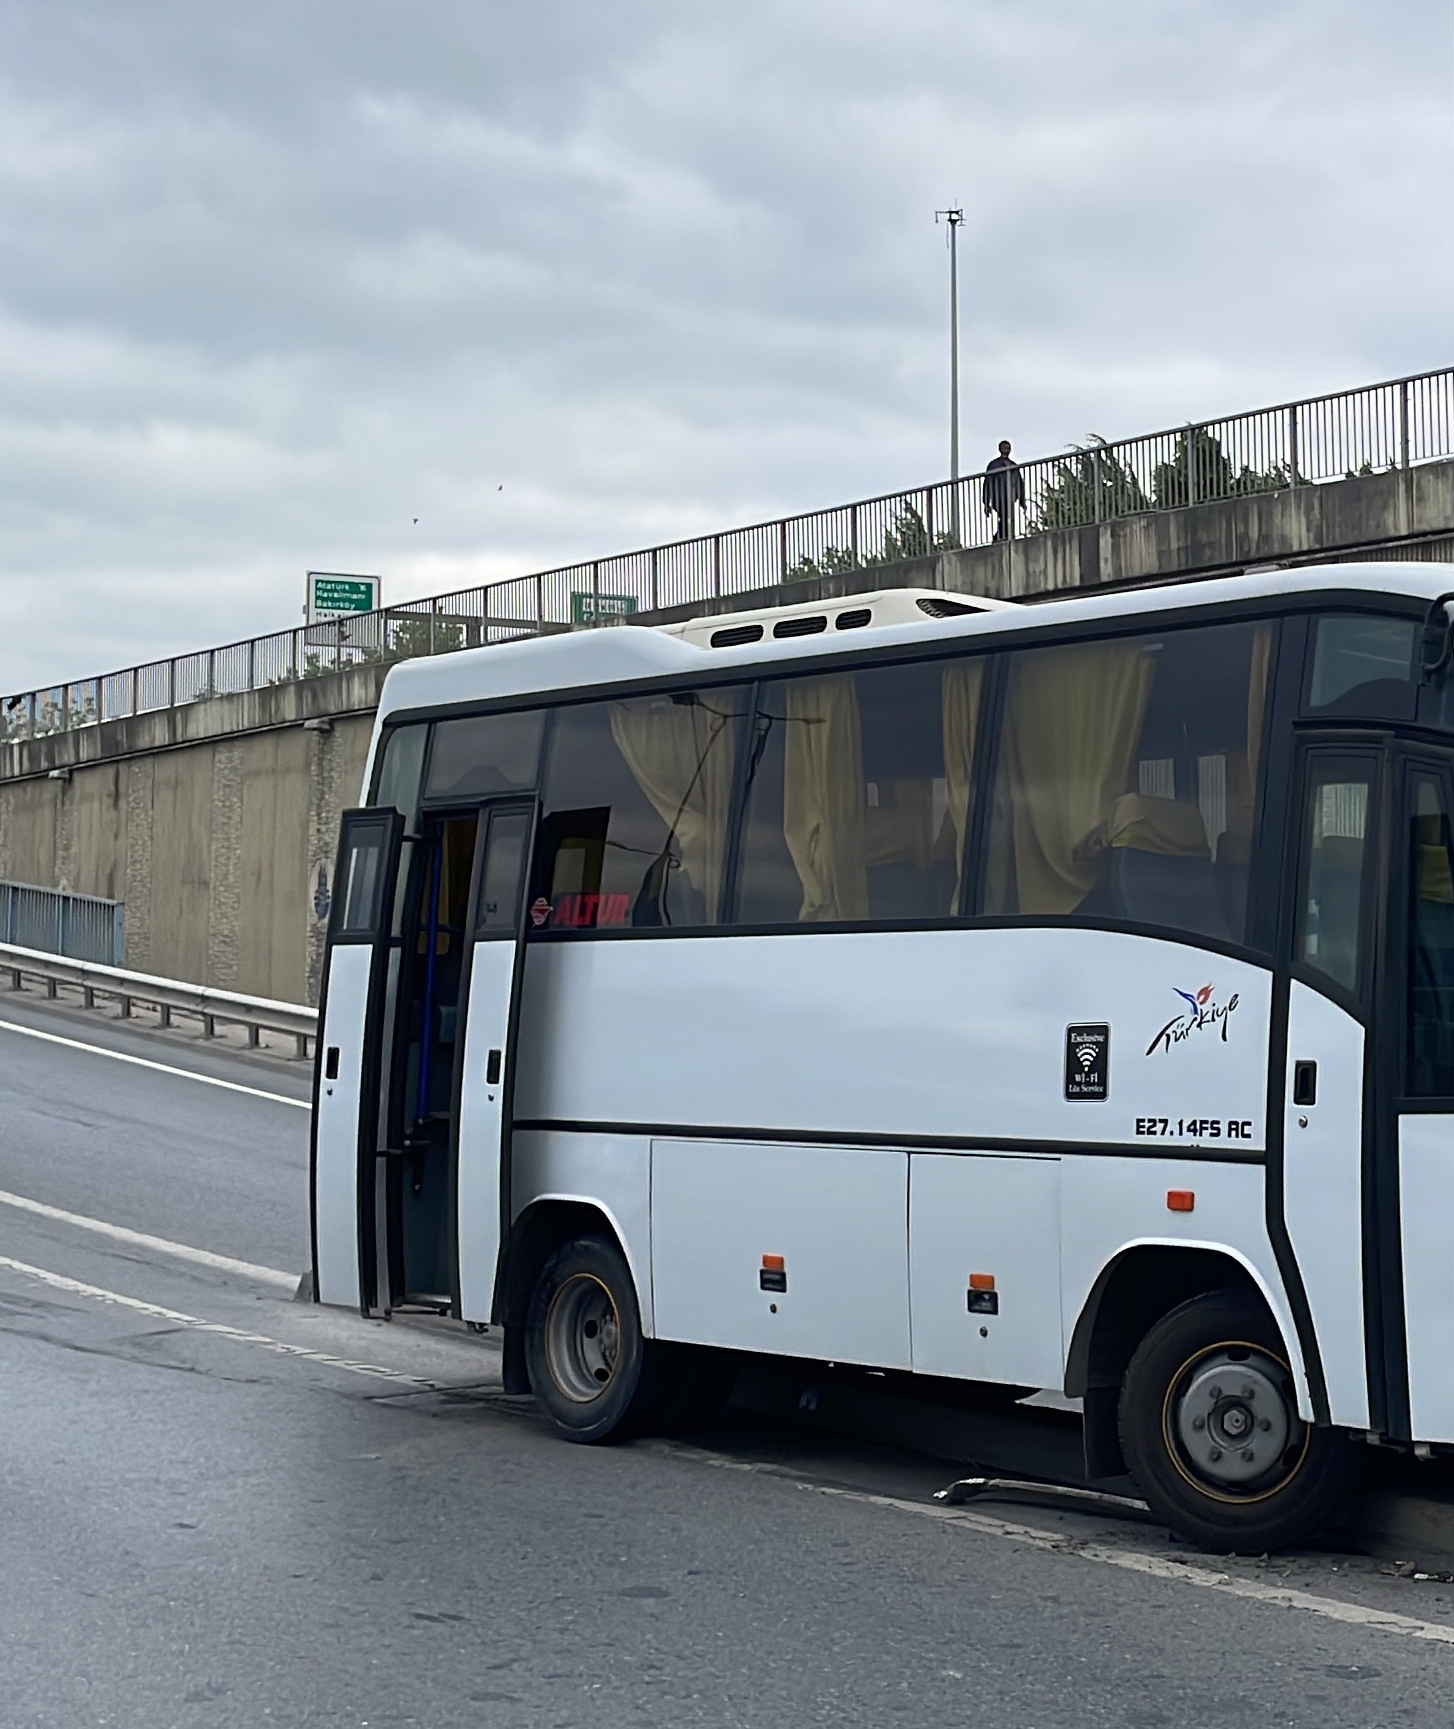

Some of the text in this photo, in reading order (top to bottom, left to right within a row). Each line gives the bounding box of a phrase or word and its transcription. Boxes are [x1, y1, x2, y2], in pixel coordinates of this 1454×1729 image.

[316, 600, 355, 610] Bakırköy
[553, 894, 629, 925] ALTUR
[1146, 994, 1239, 1056] Türkiye
[1071, 1033, 1105, 1043] Exclusive
[1135, 1118, 1252, 1139] E27.14FS AC
